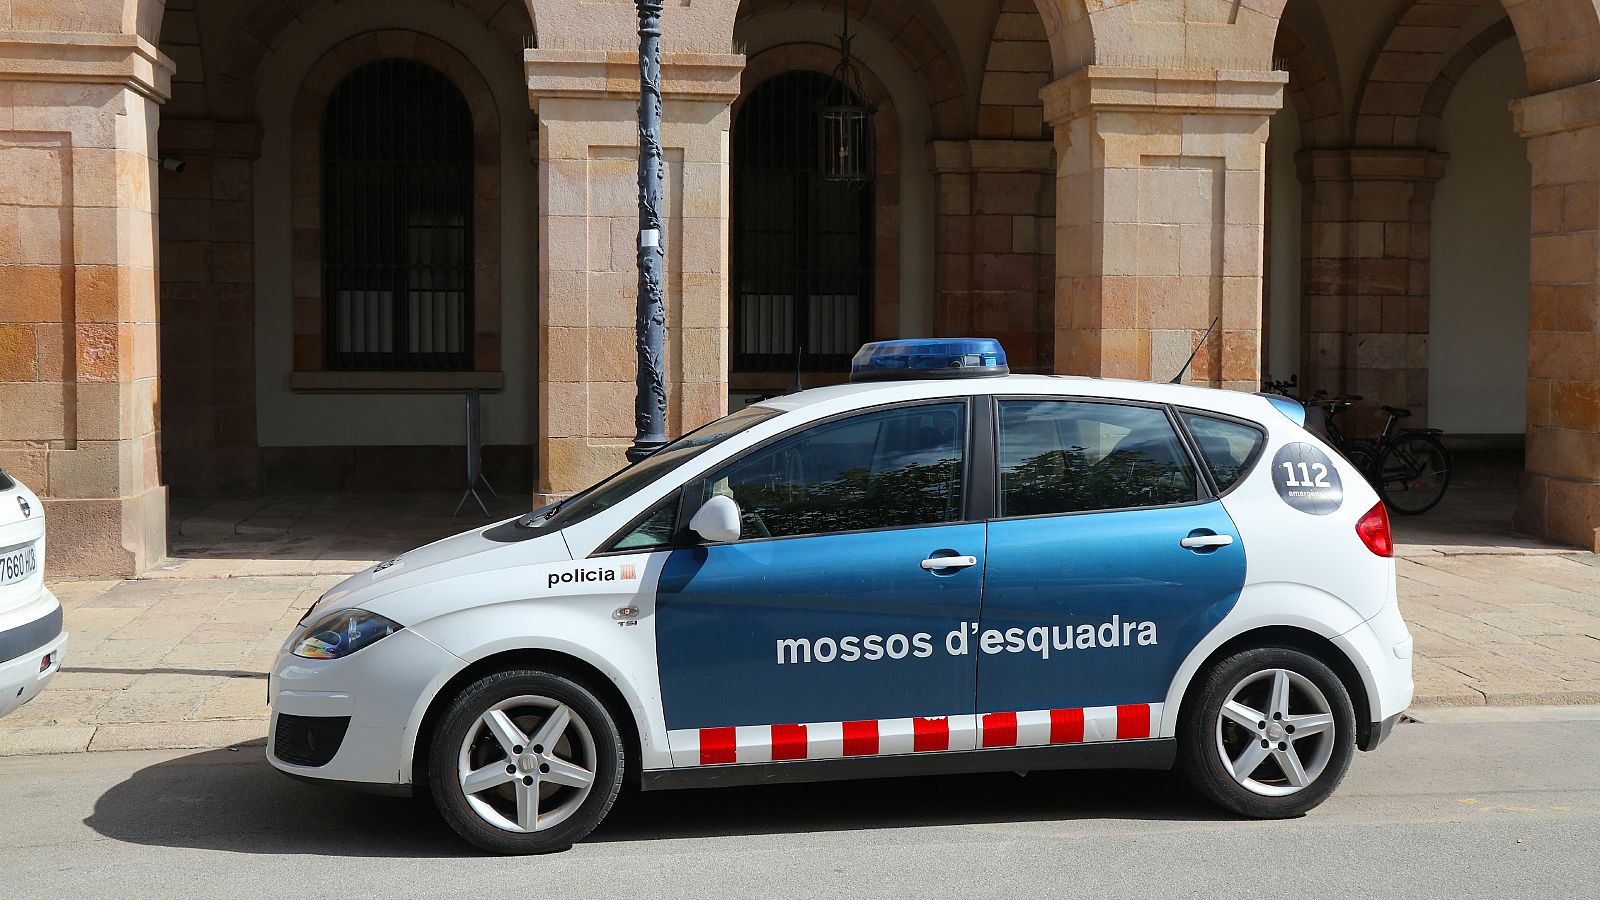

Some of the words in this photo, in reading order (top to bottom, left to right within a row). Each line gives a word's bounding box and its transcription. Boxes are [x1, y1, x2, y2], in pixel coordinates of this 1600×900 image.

[1282, 461, 1331, 488] 112
[0, 553, 24, 582] 7660
[548, 568, 615, 589] policia
[776, 632, 933, 665] mossos
